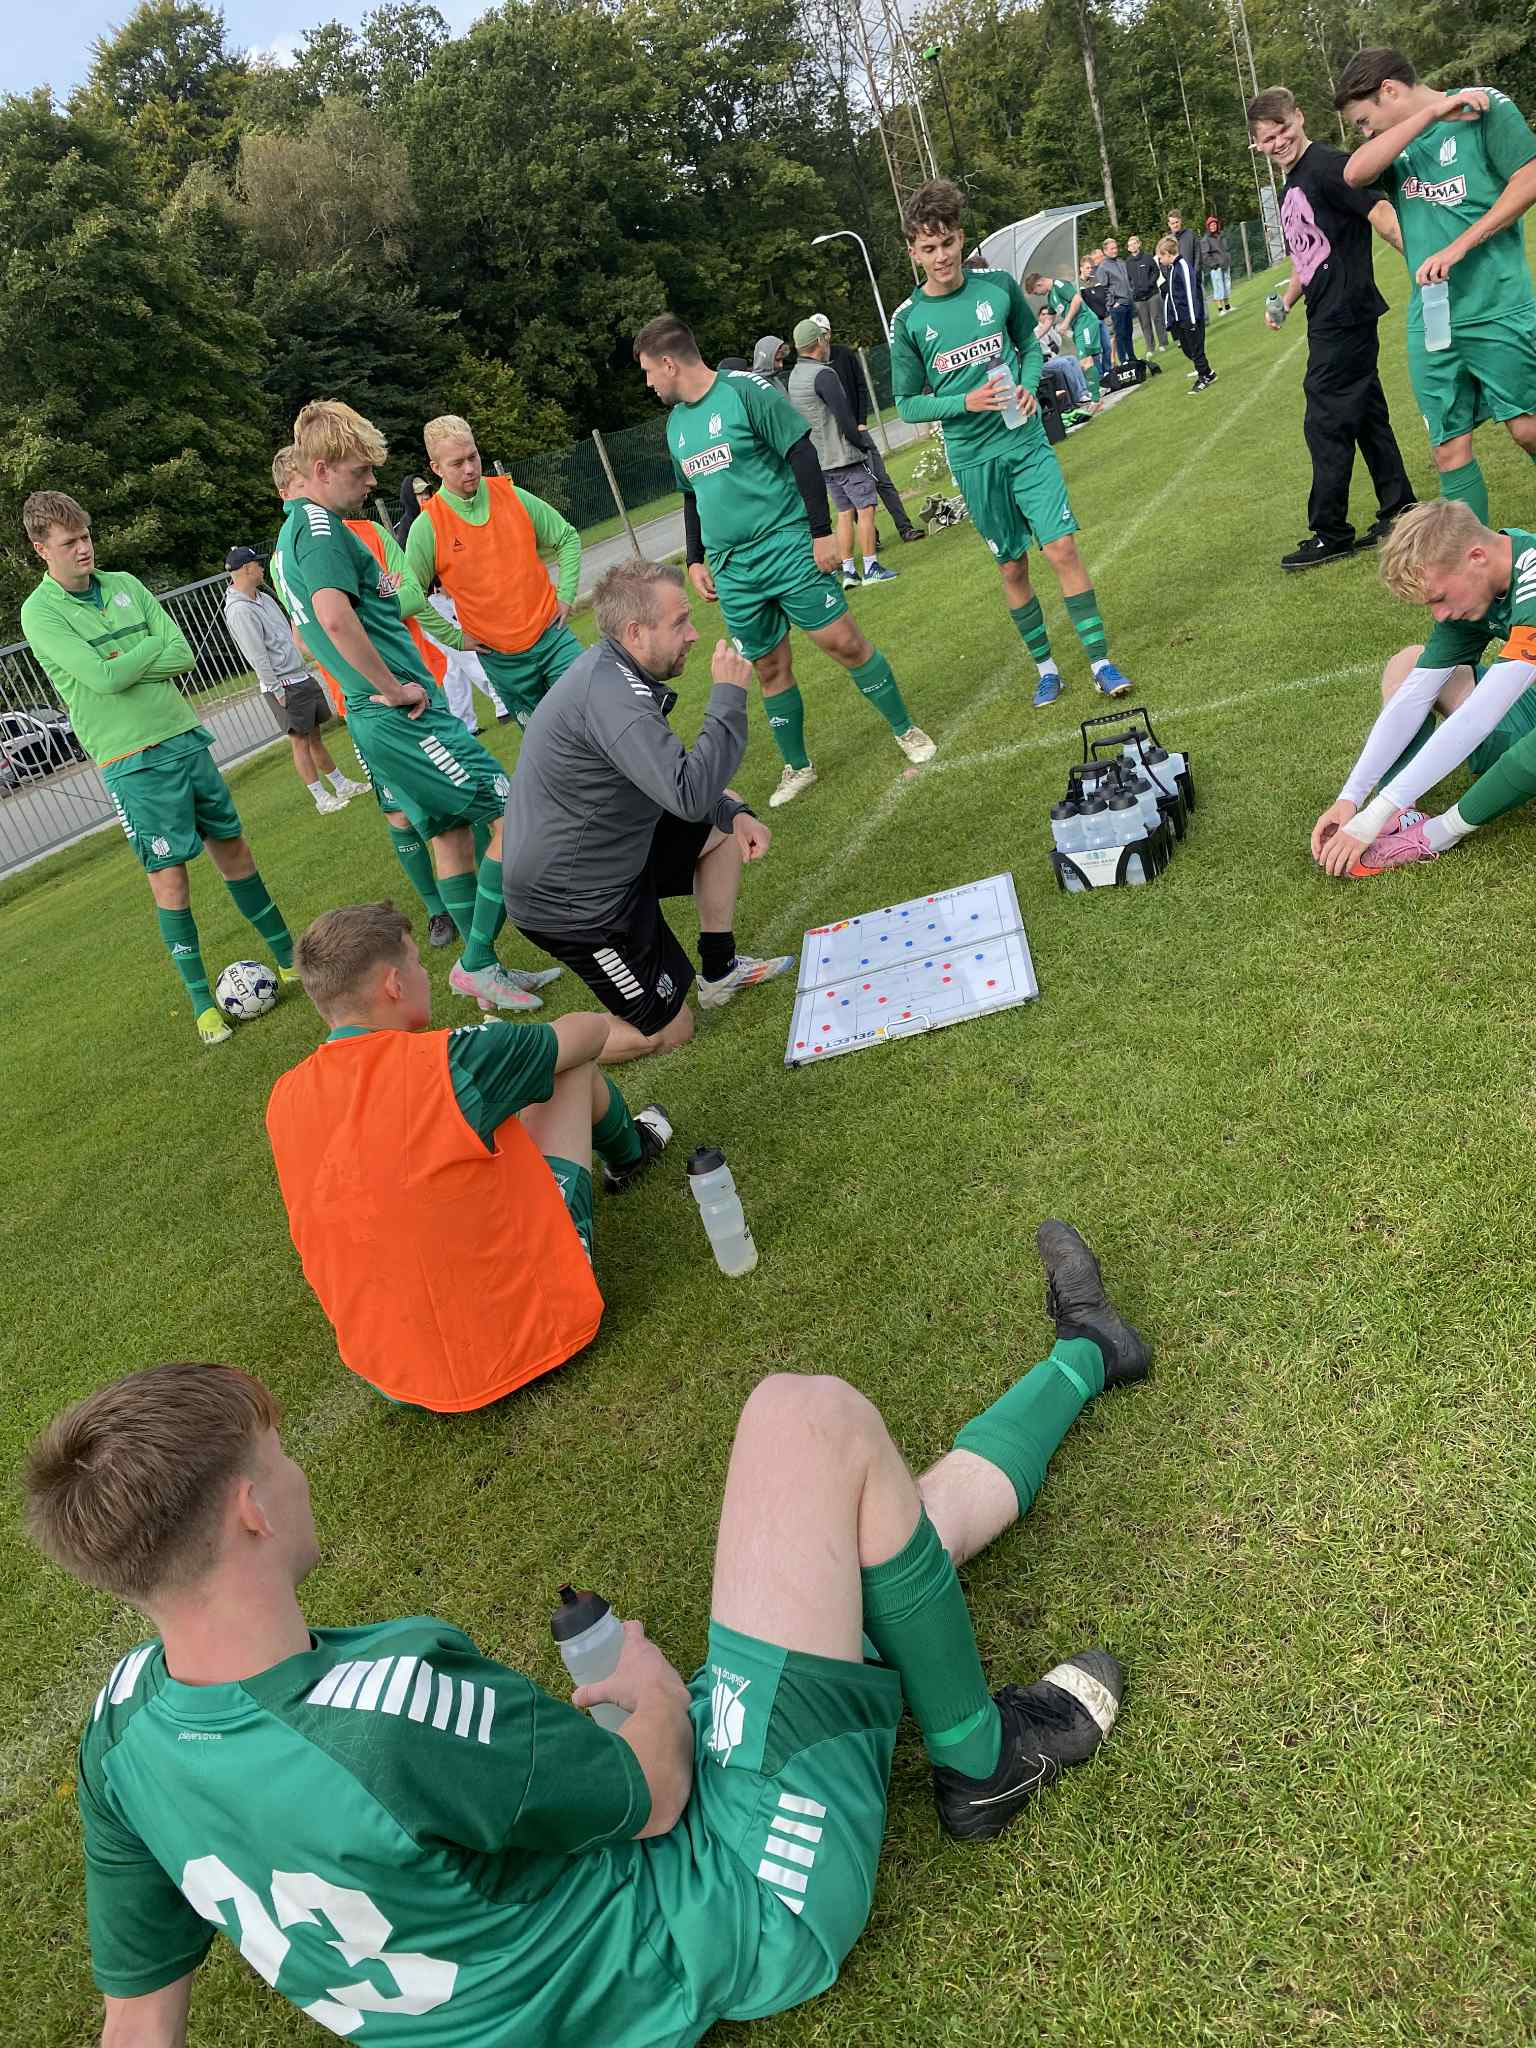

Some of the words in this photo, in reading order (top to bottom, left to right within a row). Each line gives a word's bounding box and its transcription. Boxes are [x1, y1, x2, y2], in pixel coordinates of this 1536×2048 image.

[950, 338, 1000, 365] BYGMA
[688, 449, 727, 472] BYGMA
[227, 967, 249, 996] SELECT
[823, 1030, 876, 1049] SELECT
[181, 1854, 459, 2036] 23
